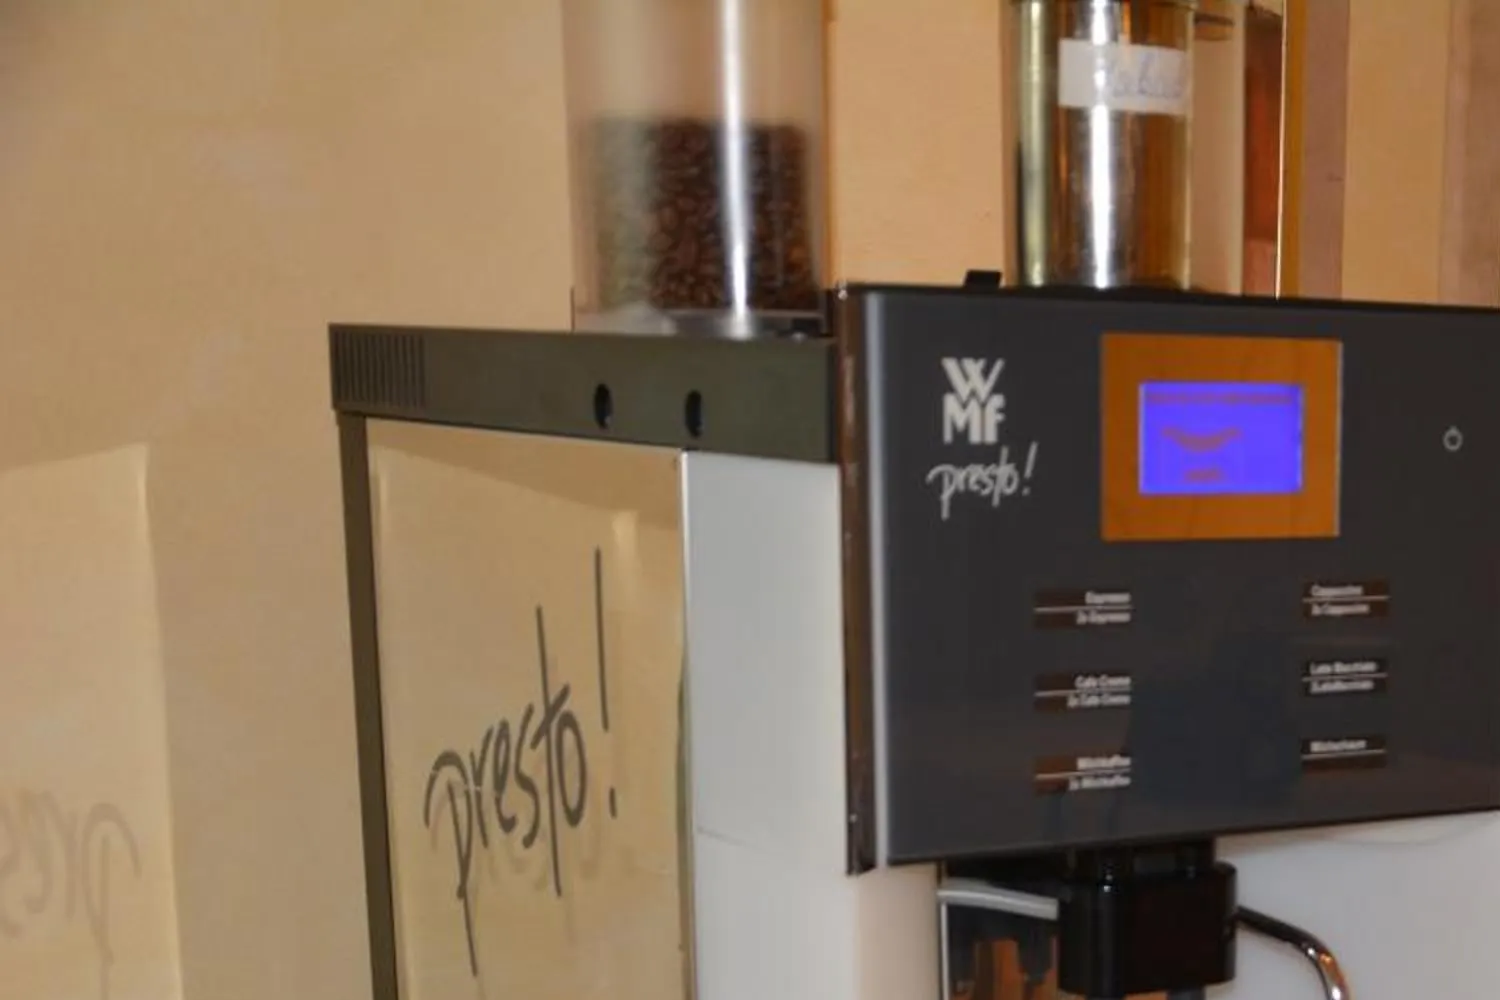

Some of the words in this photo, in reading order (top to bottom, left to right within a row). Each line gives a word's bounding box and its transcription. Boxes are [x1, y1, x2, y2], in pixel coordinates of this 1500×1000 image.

[941, 357, 1005, 444] WMF
[925, 441, 1039, 520] presto!
[423, 547, 617, 977] presto!
